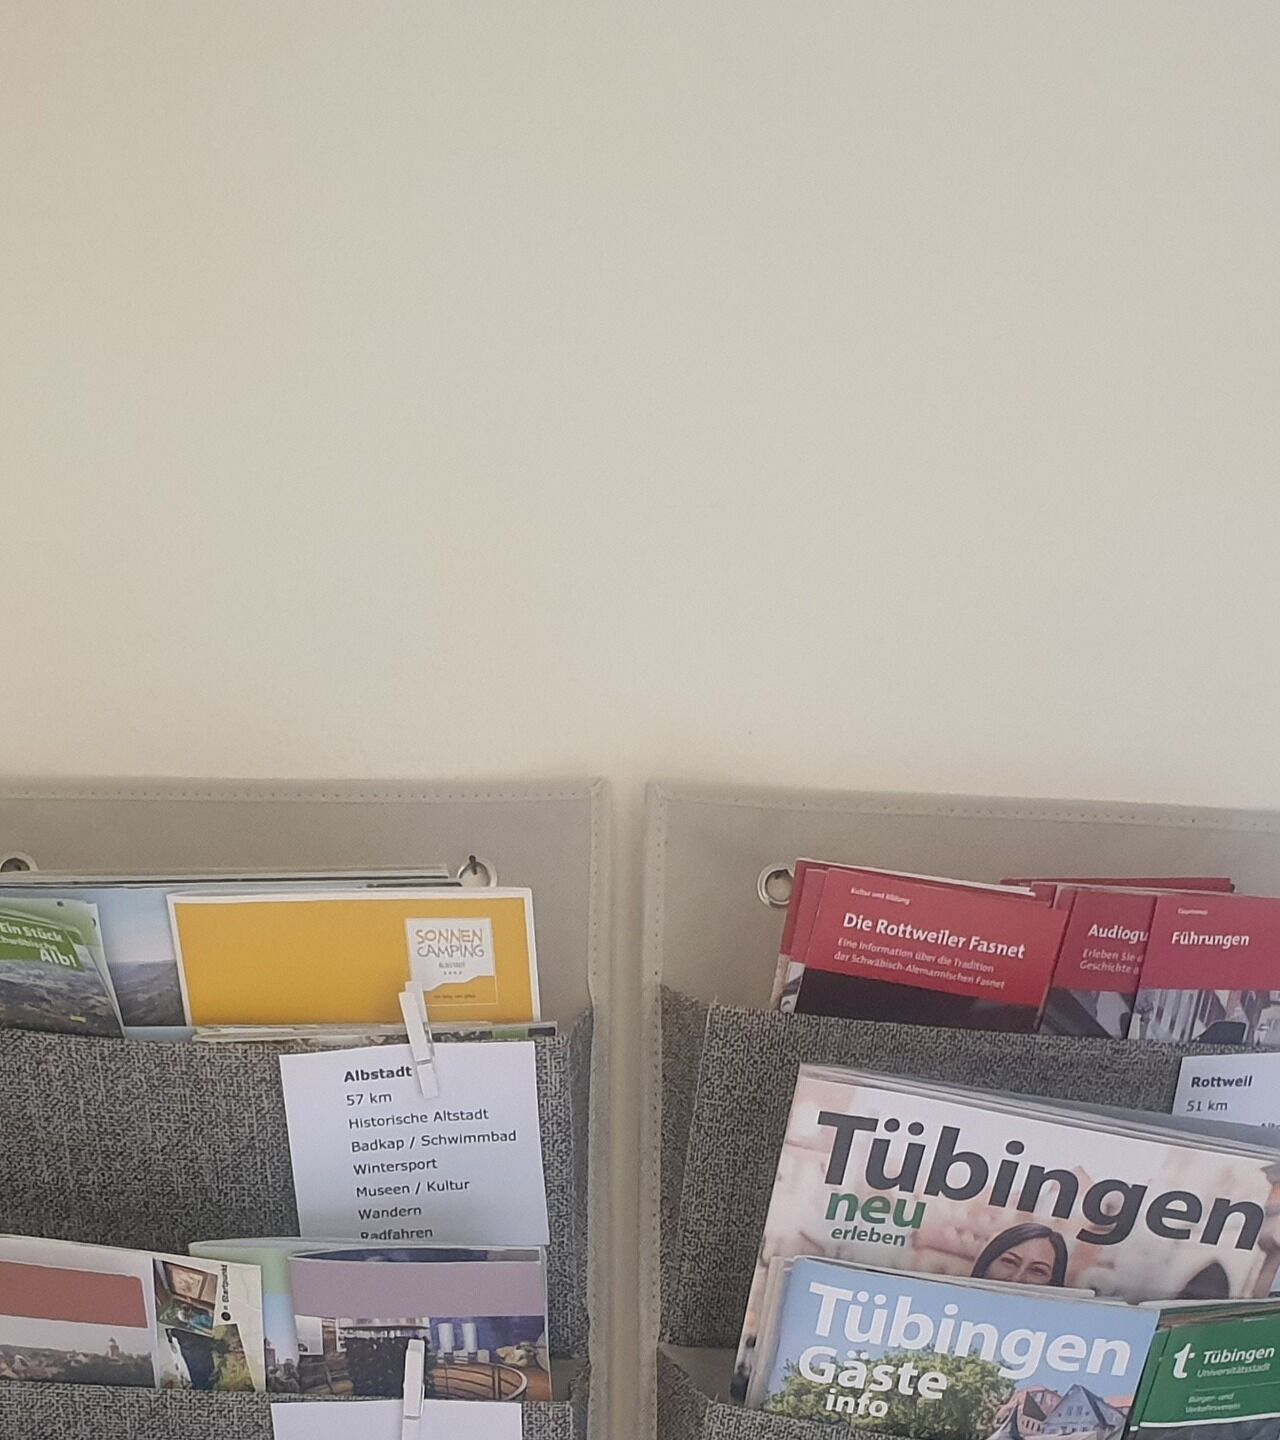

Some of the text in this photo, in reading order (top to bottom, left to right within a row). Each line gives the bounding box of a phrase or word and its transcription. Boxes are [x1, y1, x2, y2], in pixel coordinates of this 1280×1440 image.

[22, 926, 64, 943] Stück
[416, 928, 482, 944] SONNEN
[843, 912, 1025, 959] Die Rottweiler Fasnet
[1171, 931, 1250, 950] Führungen
[40, 948, 77, 967] Alb!
[417, 944, 484, 958] CAMPING
[838, 937, 994, 973] Eine Information über die Tradition
[834, 951, 1005, 989] der Schwäbisch-Alemannischen Fasnet
[1080, 960, 1131, 974] Geschichte
[344, 1066, 412, 1082] Albstadt
[1190, 1075, 1253, 1089] Rottweil
[346, 1093, 392, 1106] 57 km
[1186, 1100, 1228, 1112] 51 km
[348, 1109, 489, 1129] Historische Altstadt
[352, 1138, 404, 1153] Badkap
[421, 1131, 516, 1146] Schwimmbad
[353, 1158, 437, 1175] Wintersport
[357, 1184, 410, 1197] Museen
[427, 1180, 470, 1192] Kultur
[817, 1109, 1266, 1251] Tübingen
[358, 1206, 421, 1220] Wandern
[825, 1191, 927, 1229] neu
[831, 1224, 908, 1248] erleben
[809, 1281, 1132, 1381] Tübingen
[1202, 1347, 1275, 1365] Tübingen
[798, 1345, 949, 1400] Gäste
[1197, 1362, 1271, 1378] Universitätsstadt
[824, 1388, 890, 1419] info
